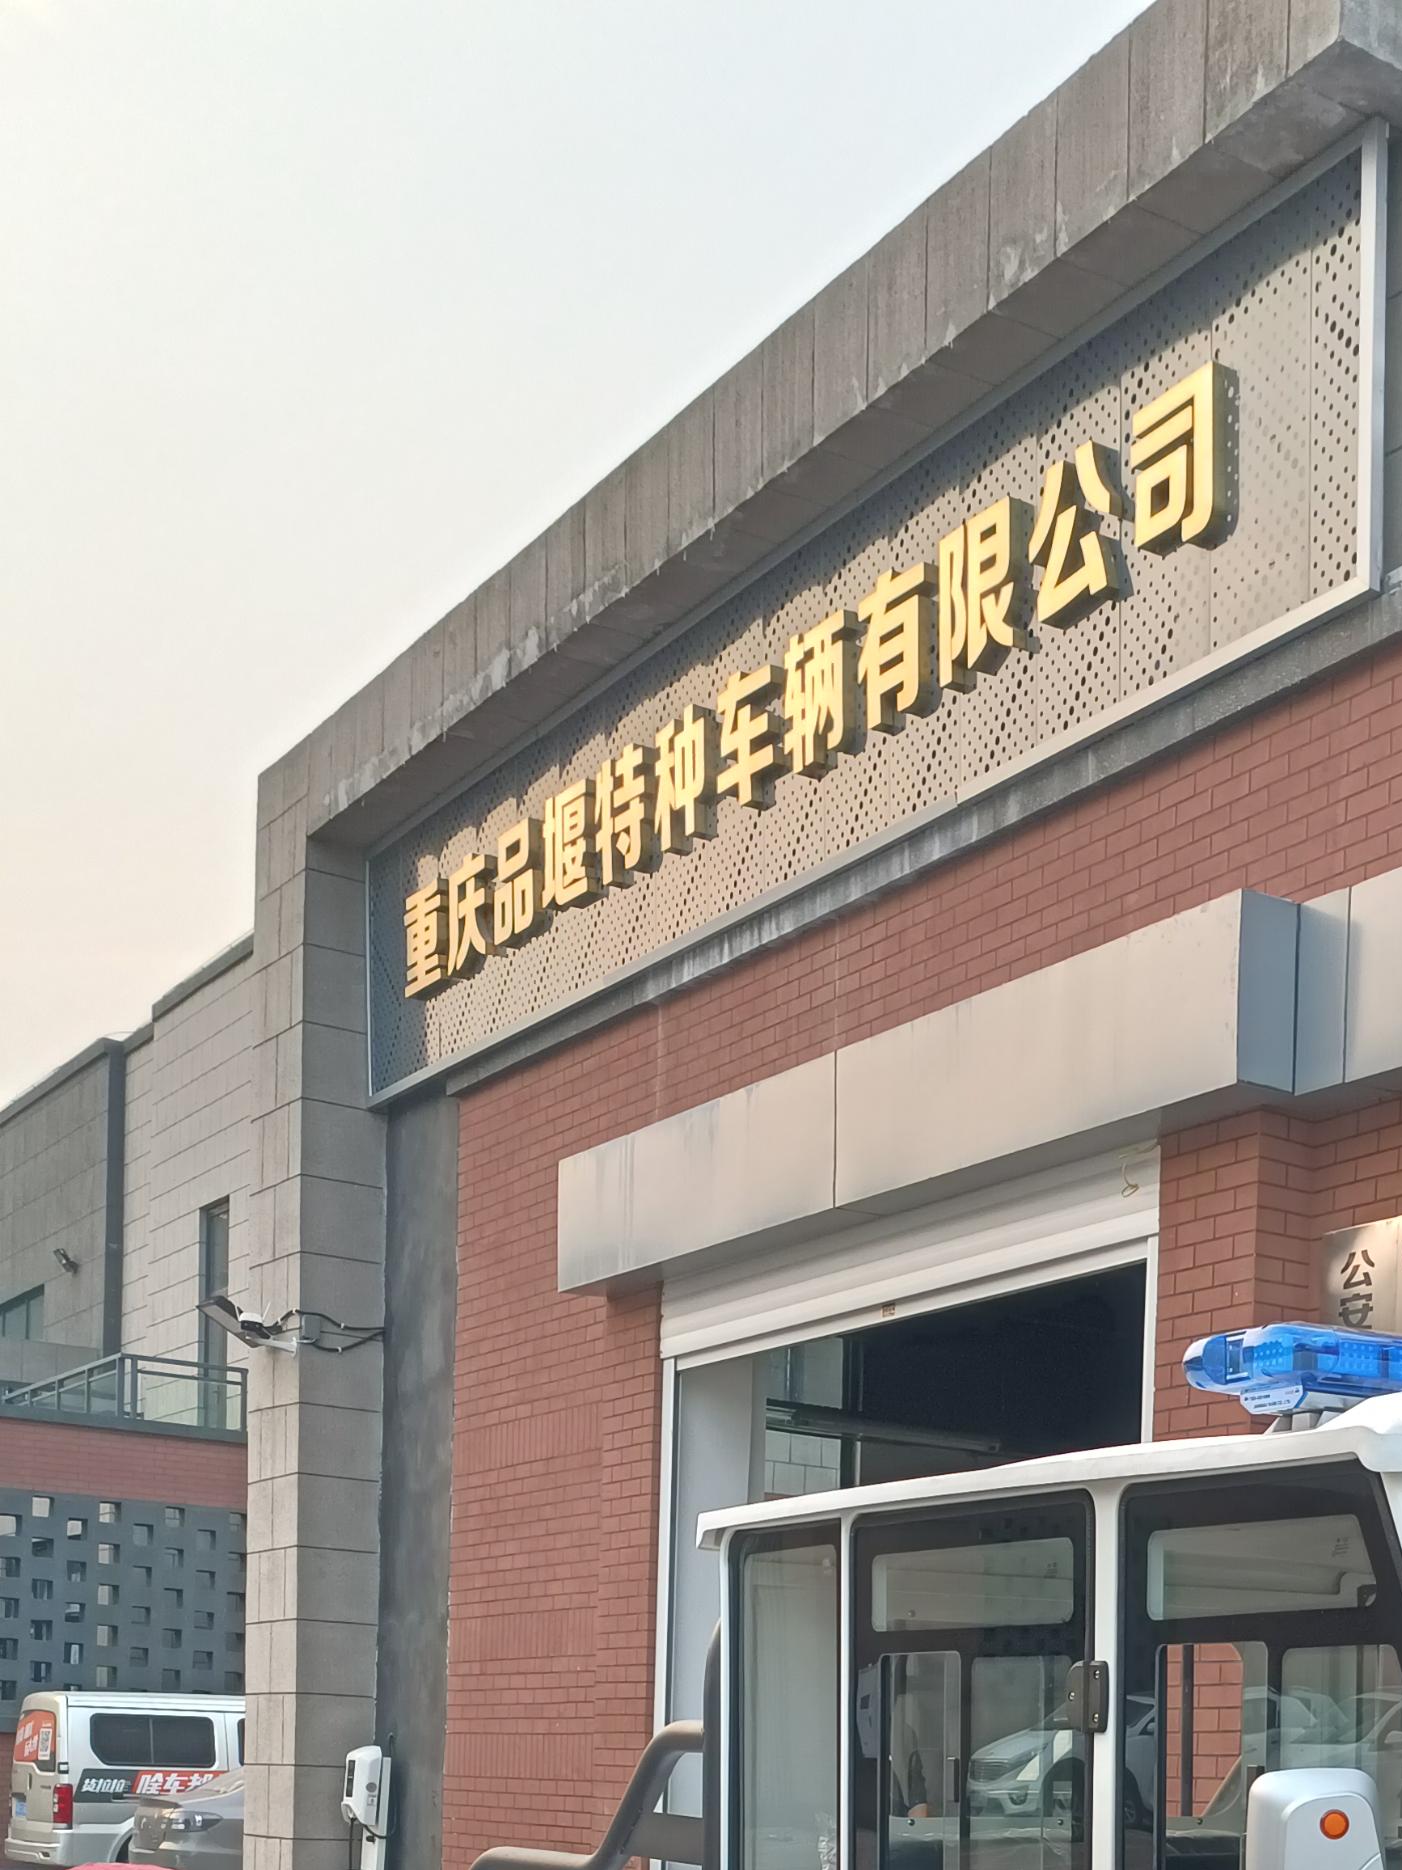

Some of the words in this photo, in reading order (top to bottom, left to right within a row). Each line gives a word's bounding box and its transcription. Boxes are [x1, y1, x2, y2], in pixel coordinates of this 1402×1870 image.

[403, 361, 1222, 998] 重庆品堰特种车辆有限公司
